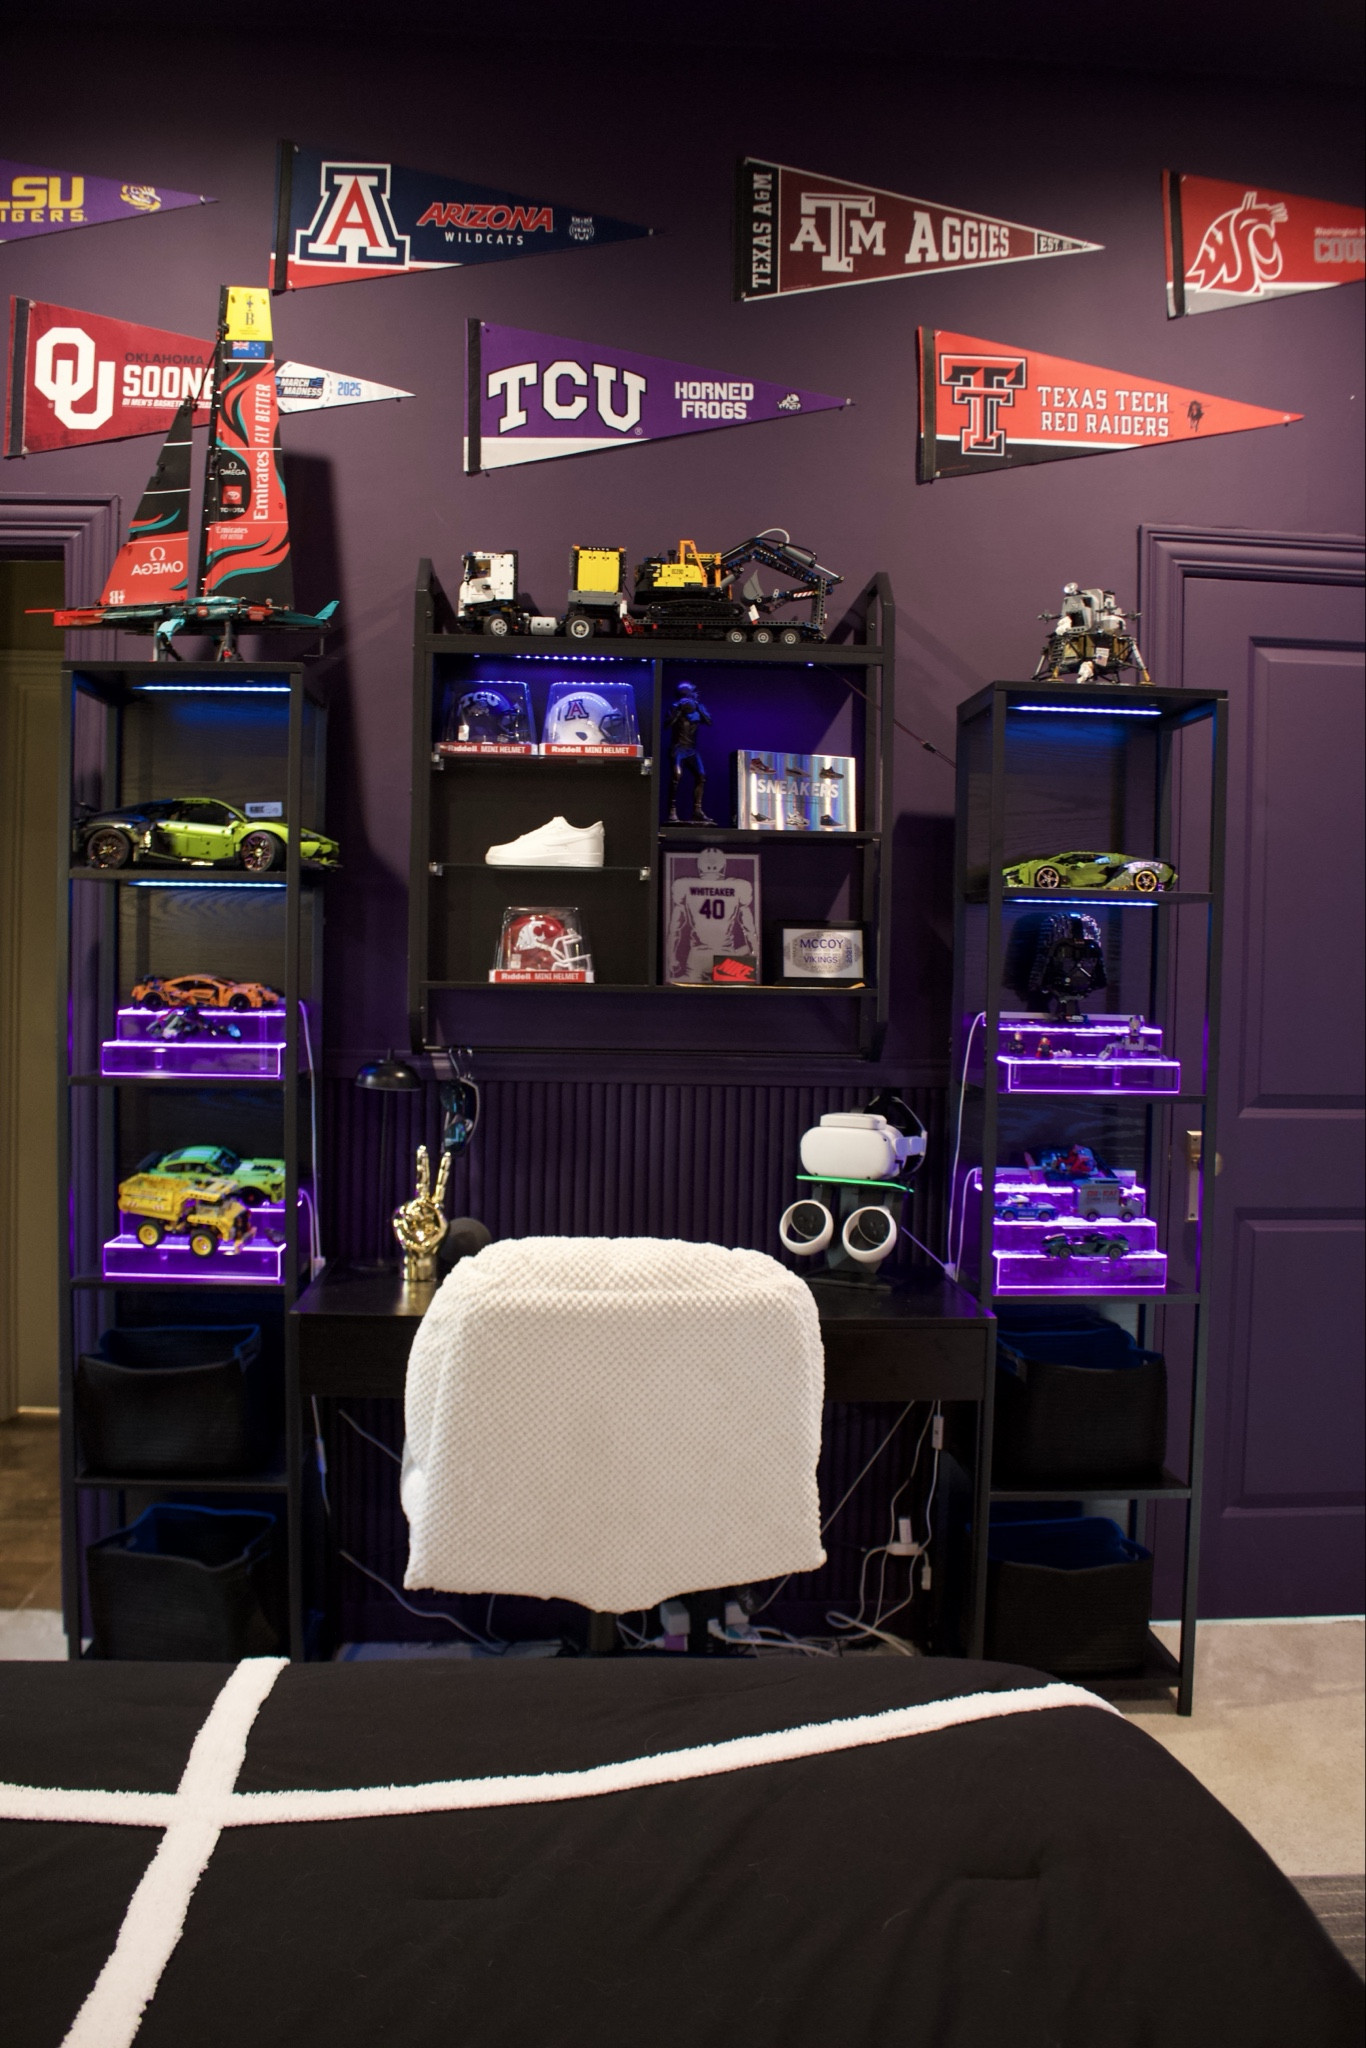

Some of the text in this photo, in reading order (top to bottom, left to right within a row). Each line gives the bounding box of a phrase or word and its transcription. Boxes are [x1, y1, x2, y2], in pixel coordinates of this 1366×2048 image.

[0, 209, 84, 223] IGERS
[295, 161, 410, 270] A
[416, 202, 554, 233] ARIZONA
[445, 231, 524, 246] WILDCATS
[752, 173, 772, 288] TEXAS A&M
[1313, 237, 1366, 263] COU
[124, 352, 203, 366] OKLAHOMA
[34, 327, 116, 430] OU
[122, 364, 215, 399] SOONE
[281, 377, 310, 387] MARCH
[282, 386, 323, 397] MADNESS
[337, 381, 362, 396] 2025
[487, 359, 648, 434] TCU
[674, 381, 754, 401] HORNED
[1037, 386, 1169, 414] TEXAS TECH
[681, 400, 748, 420] FROGS
[1041, 411, 1169, 437] RED RAIDERS
[254, 383, 271, 521] Emirates FLY BETTER
[219, 468, 247, 476] OMEGA
[564, 699, 589, 721] A
[481, 745, 498, 753] MINI
[499, 745, 526, 754] HELMET
[551, 745, 630, 754] Riddell MINI HELMET
[757, 779, 840, 798] SNEAKERS
[689, 887, 736, 897] WHITEAKER
[699, 898, 726, 920] 40
[800, 939, 844, 949] MCCOY
[803, 956, 838, 964] VIKINGS
[501, 972, 580, 980] Riddell MINI HELMET
